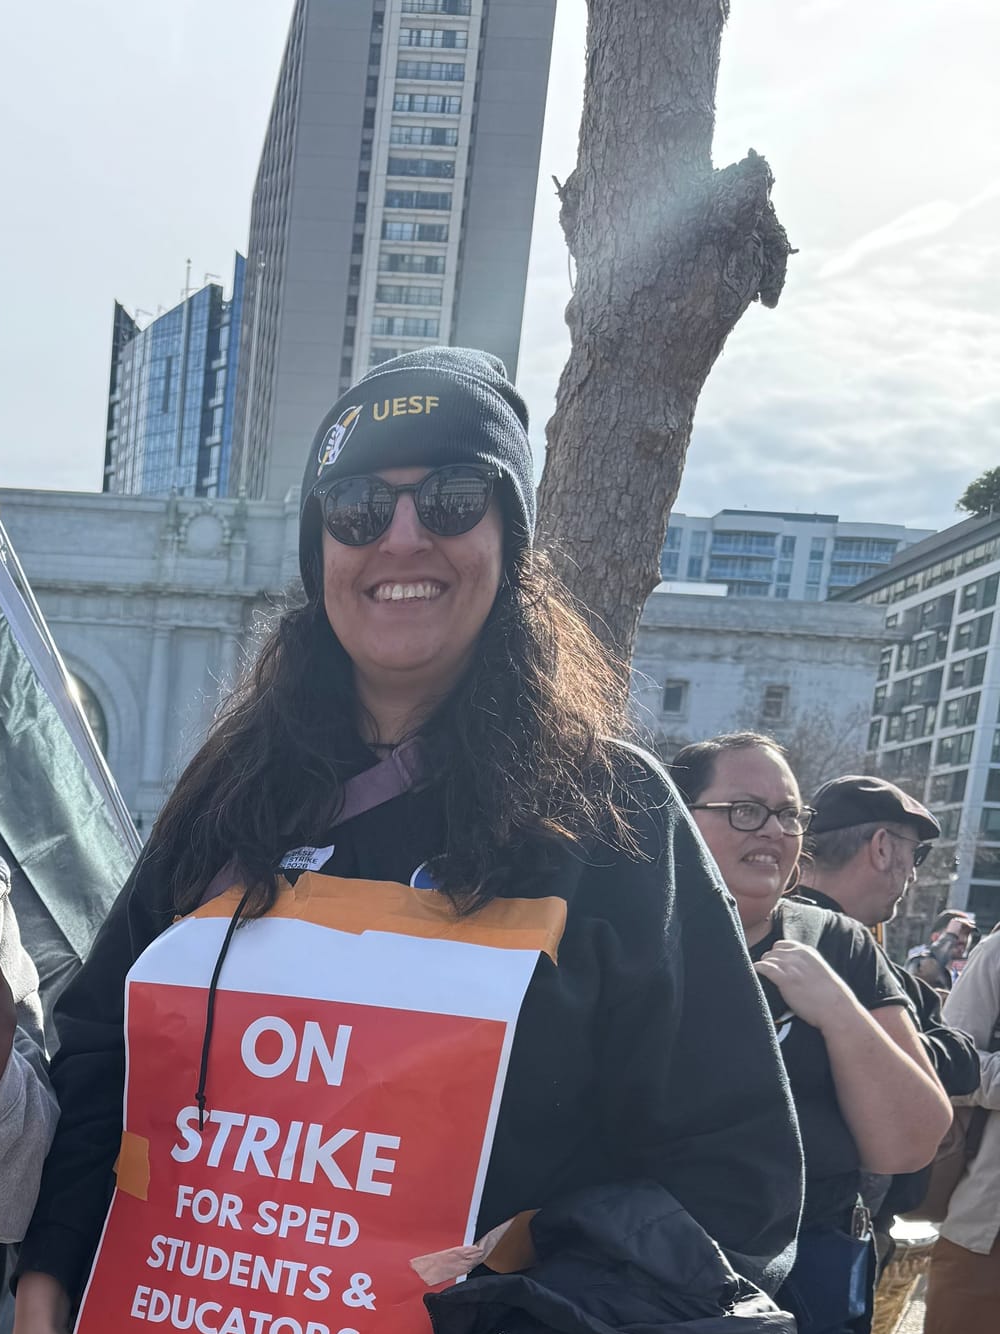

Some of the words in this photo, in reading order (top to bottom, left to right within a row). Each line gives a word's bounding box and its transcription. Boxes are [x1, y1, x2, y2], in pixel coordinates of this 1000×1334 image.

[372, 396, 440, 420] UESF
[289, 856, 318, 864] STRIKE
[240, 1015, 353, 1087] ON
[169, 1104, 402, 1198] STRIKE
[175, 1185, 245, 1230] FOR
[252, 1199, 360, 1248] SPED
[146, 1234, 333, 1302] STUDENTS
[341, 1273, 378, 1312] &
